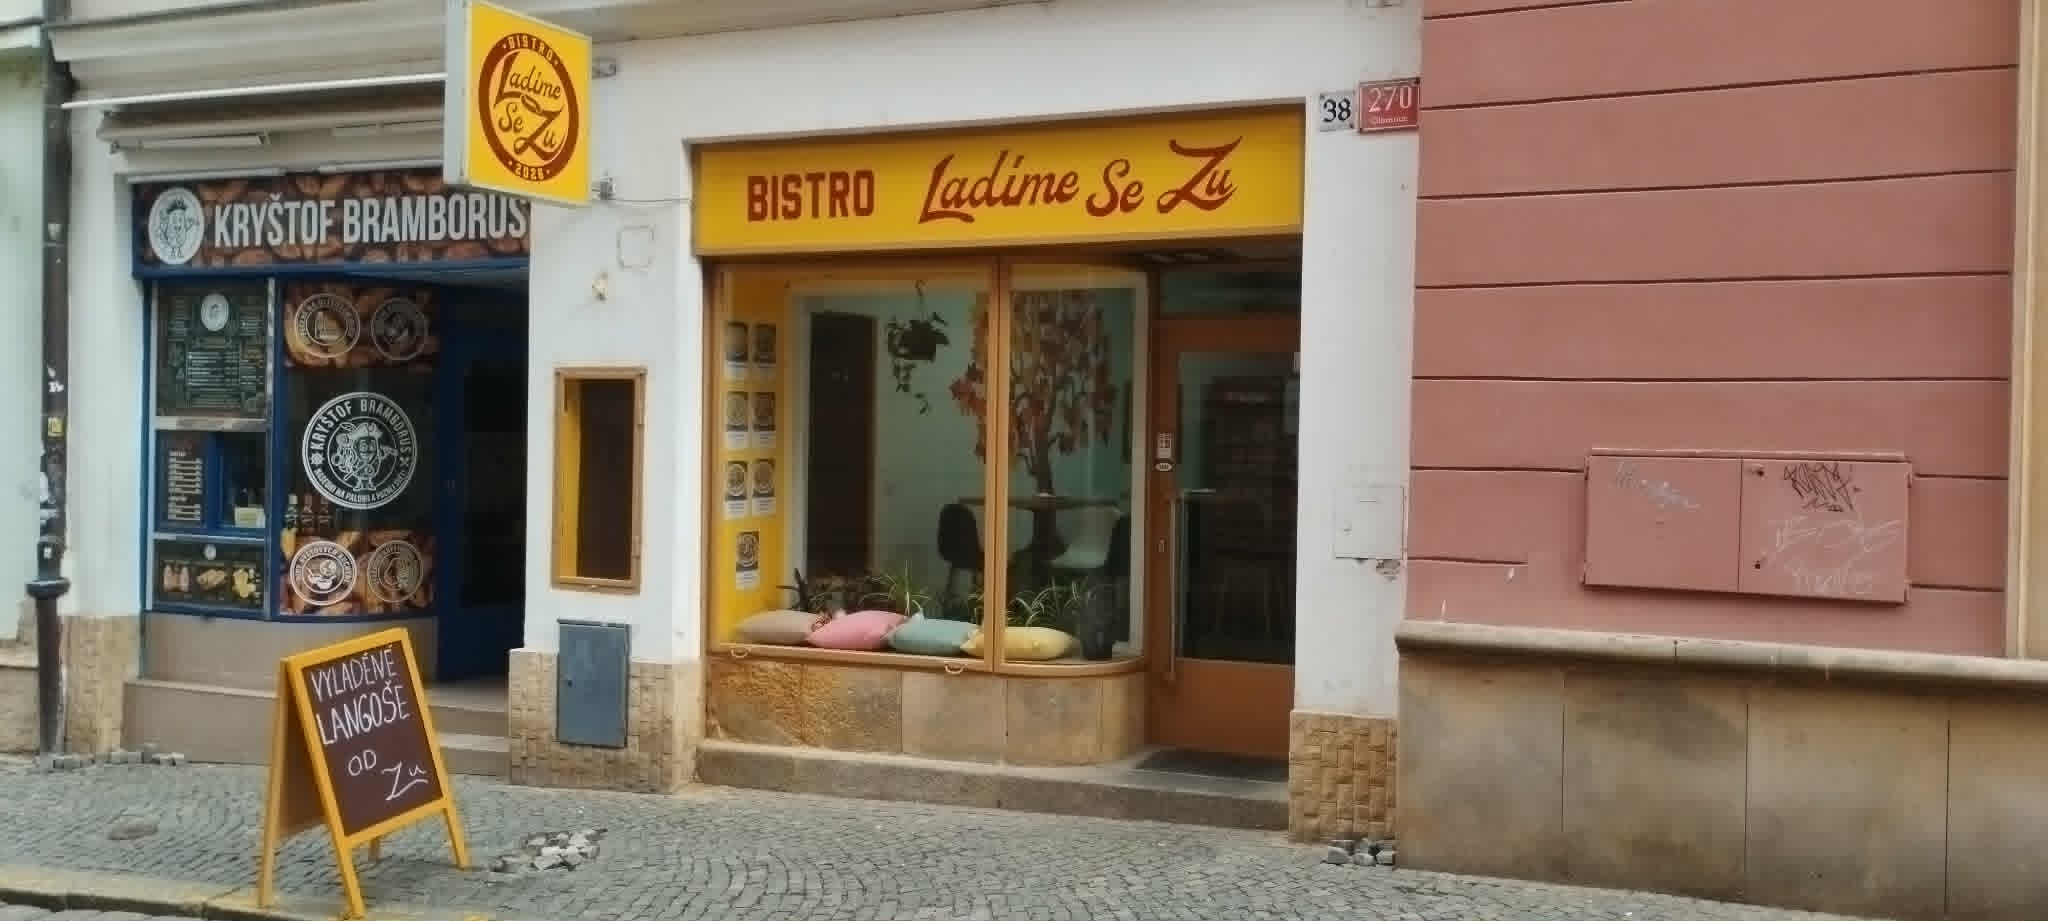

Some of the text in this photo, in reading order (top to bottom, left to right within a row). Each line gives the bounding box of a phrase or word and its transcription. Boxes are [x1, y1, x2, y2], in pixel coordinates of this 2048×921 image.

[508, 35, 553, 61] BISTRO
[493, 51, 561, 110] Ladíme
[1368, 86, 1412, 112] 270
[498, 101, 566, 160] Se Zu
[1323, 98, 1351, 122] 38
[747, 135, 1243, 223] BISTRO Ladíme Se Zu
[214, 192, 526, 248] KRYŠTOF BRAMBORUS
[360, 399, 411, 453] BRAMBORUS
[316, 679, 410, 745] LANGOŠE
[347, 749, 377, 776] OD
[381, 761, 428, 801] Zu
